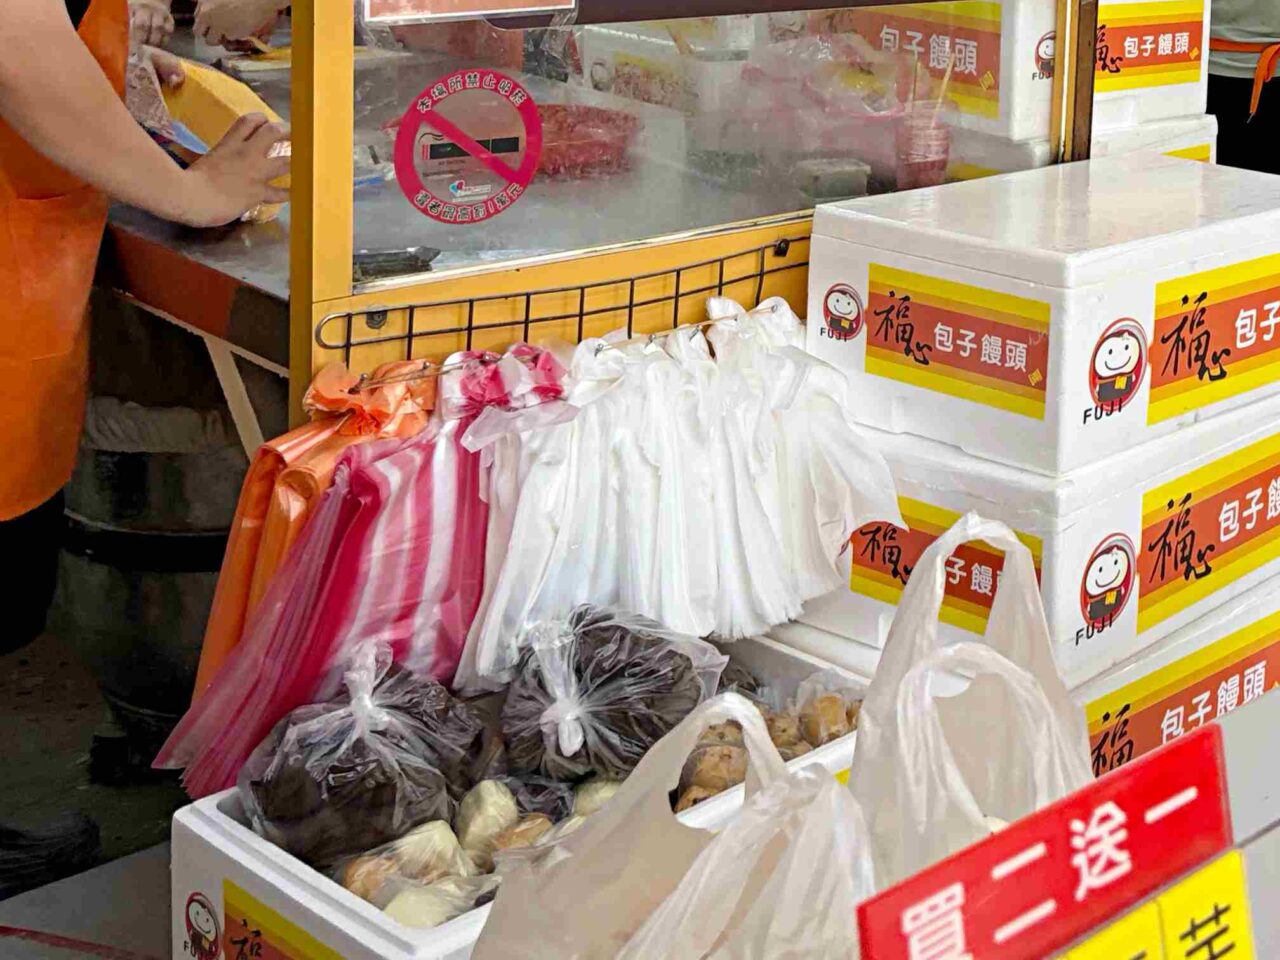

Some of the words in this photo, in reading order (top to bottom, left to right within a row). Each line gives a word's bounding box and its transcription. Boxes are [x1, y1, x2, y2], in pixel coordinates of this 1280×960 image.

[1124, 32, 1190, 58] 包子饅頭
[819, 325, 848, 343] FUJI
[933, 321, 1029, 373] 包子饅頭
[1083, 398, 1122, 425] FUJI
[1075, 618, 1113, 646] FUJI
[902, 786, 1198, 960] 買二送一
